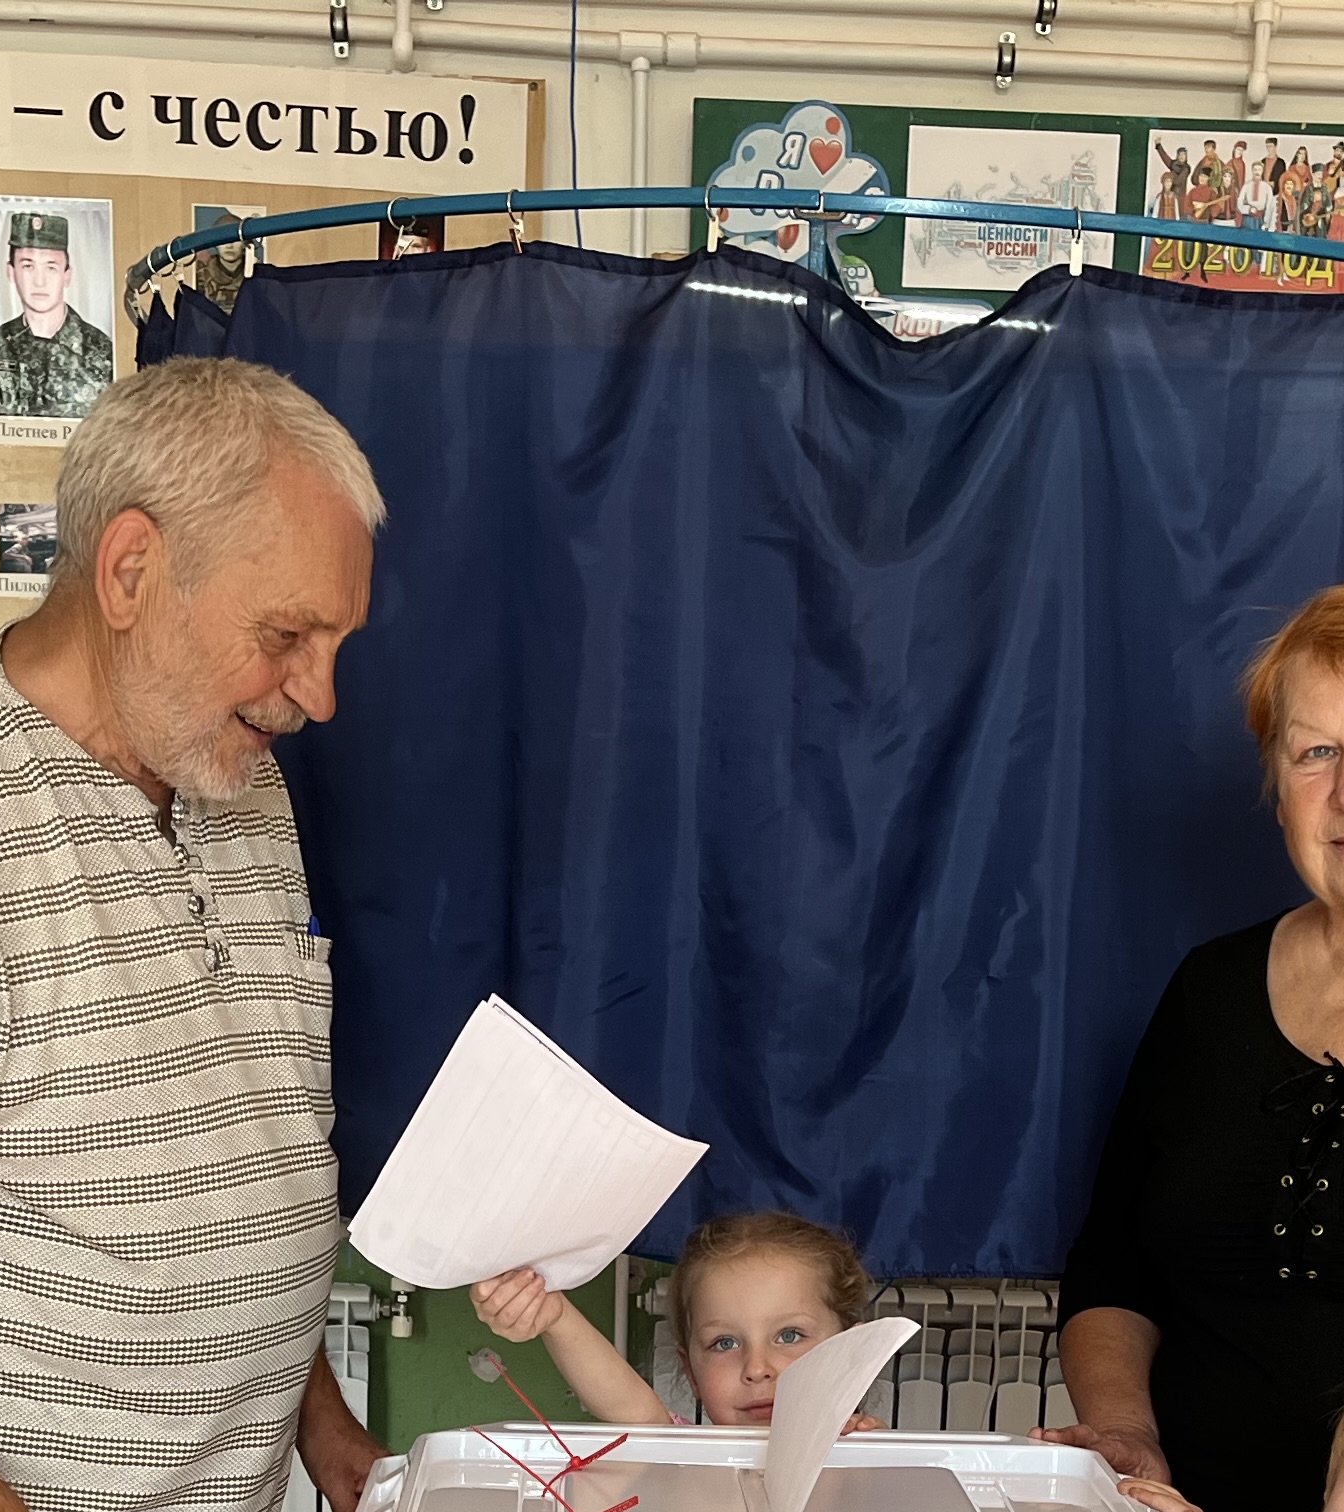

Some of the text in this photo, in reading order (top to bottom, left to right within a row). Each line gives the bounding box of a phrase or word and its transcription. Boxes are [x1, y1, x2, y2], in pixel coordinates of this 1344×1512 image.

[88, 90, 126, 141] с
[150, 93, 477, 165] честью!
[777, 132, 806, 170] Я
[977, 225, 1048, 242] ЦЕННОСТИ
[986, 241, 1038, 257] РОССИИ
